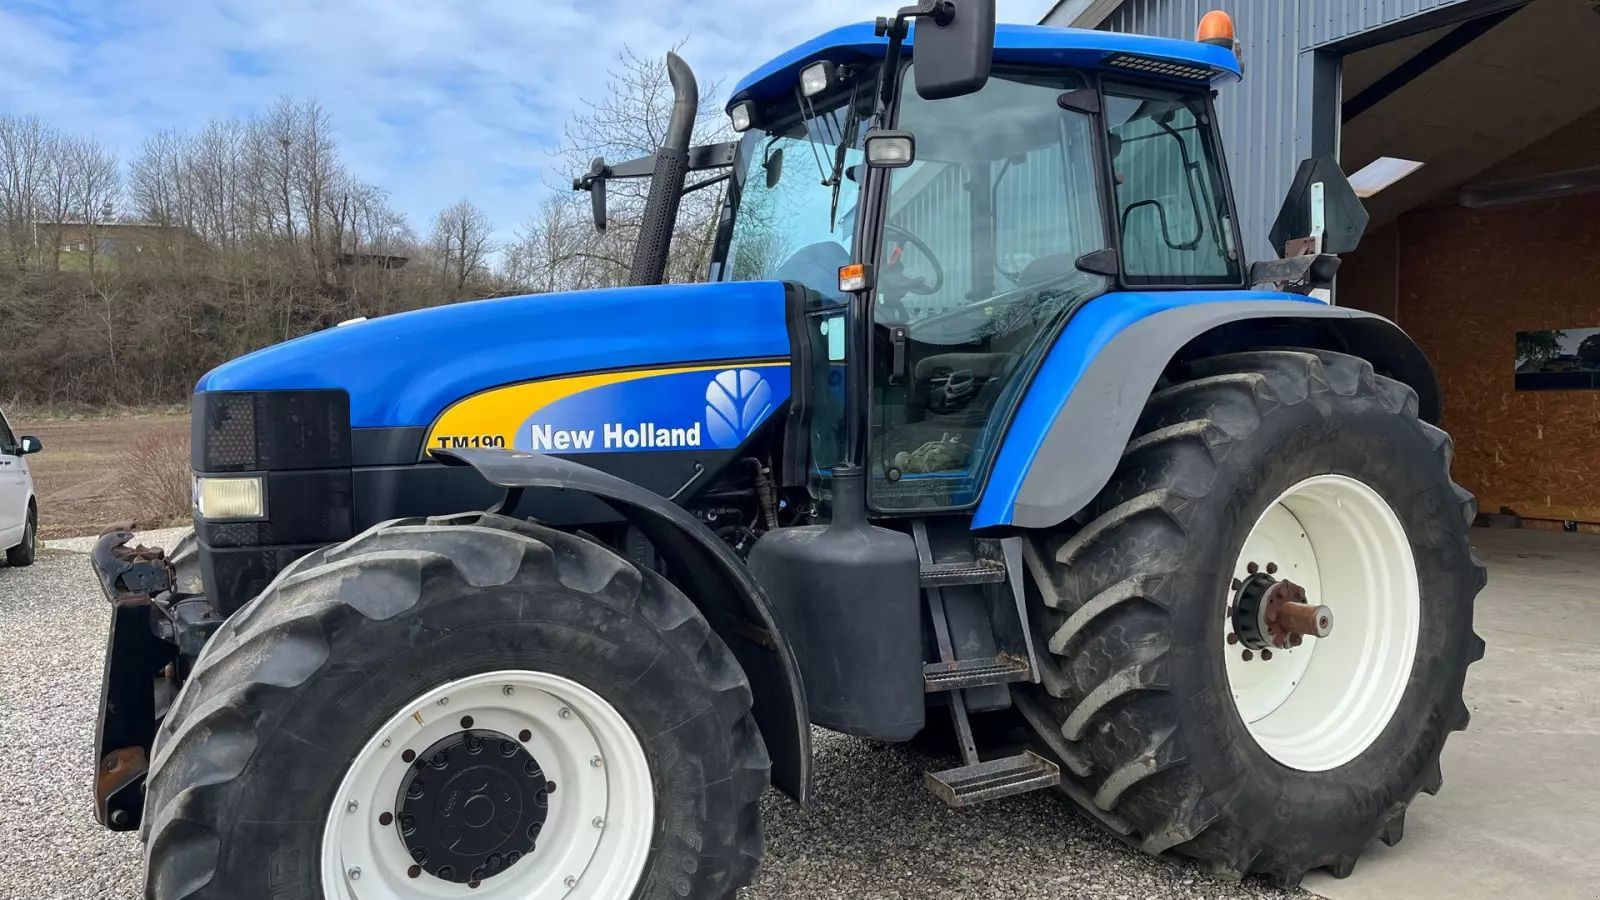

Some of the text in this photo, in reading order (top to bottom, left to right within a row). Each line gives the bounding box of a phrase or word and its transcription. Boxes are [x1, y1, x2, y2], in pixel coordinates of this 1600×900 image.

[437, 435, 505, 449] TM190
[531, 422, 700, 450] New Holland
